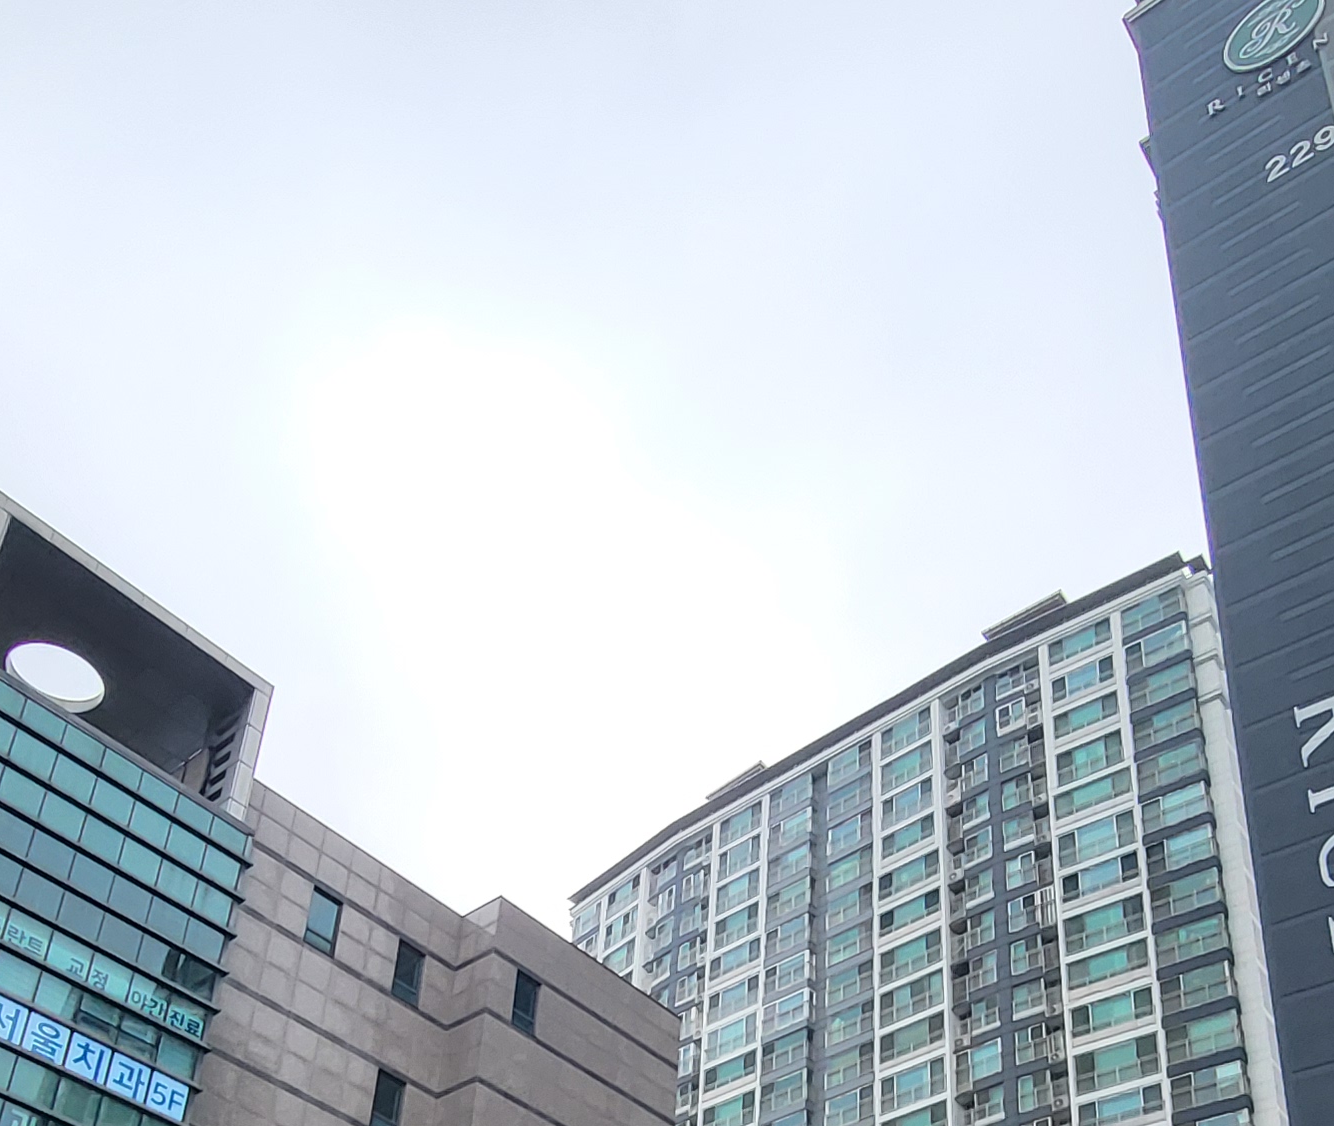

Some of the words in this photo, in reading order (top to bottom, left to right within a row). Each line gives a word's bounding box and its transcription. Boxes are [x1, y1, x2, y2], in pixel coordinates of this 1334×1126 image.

[66, 957, 109, 992] 교정
[131, 989, 203, 1040] 야간진료
[151, 1081, 186, 1112] 5F
